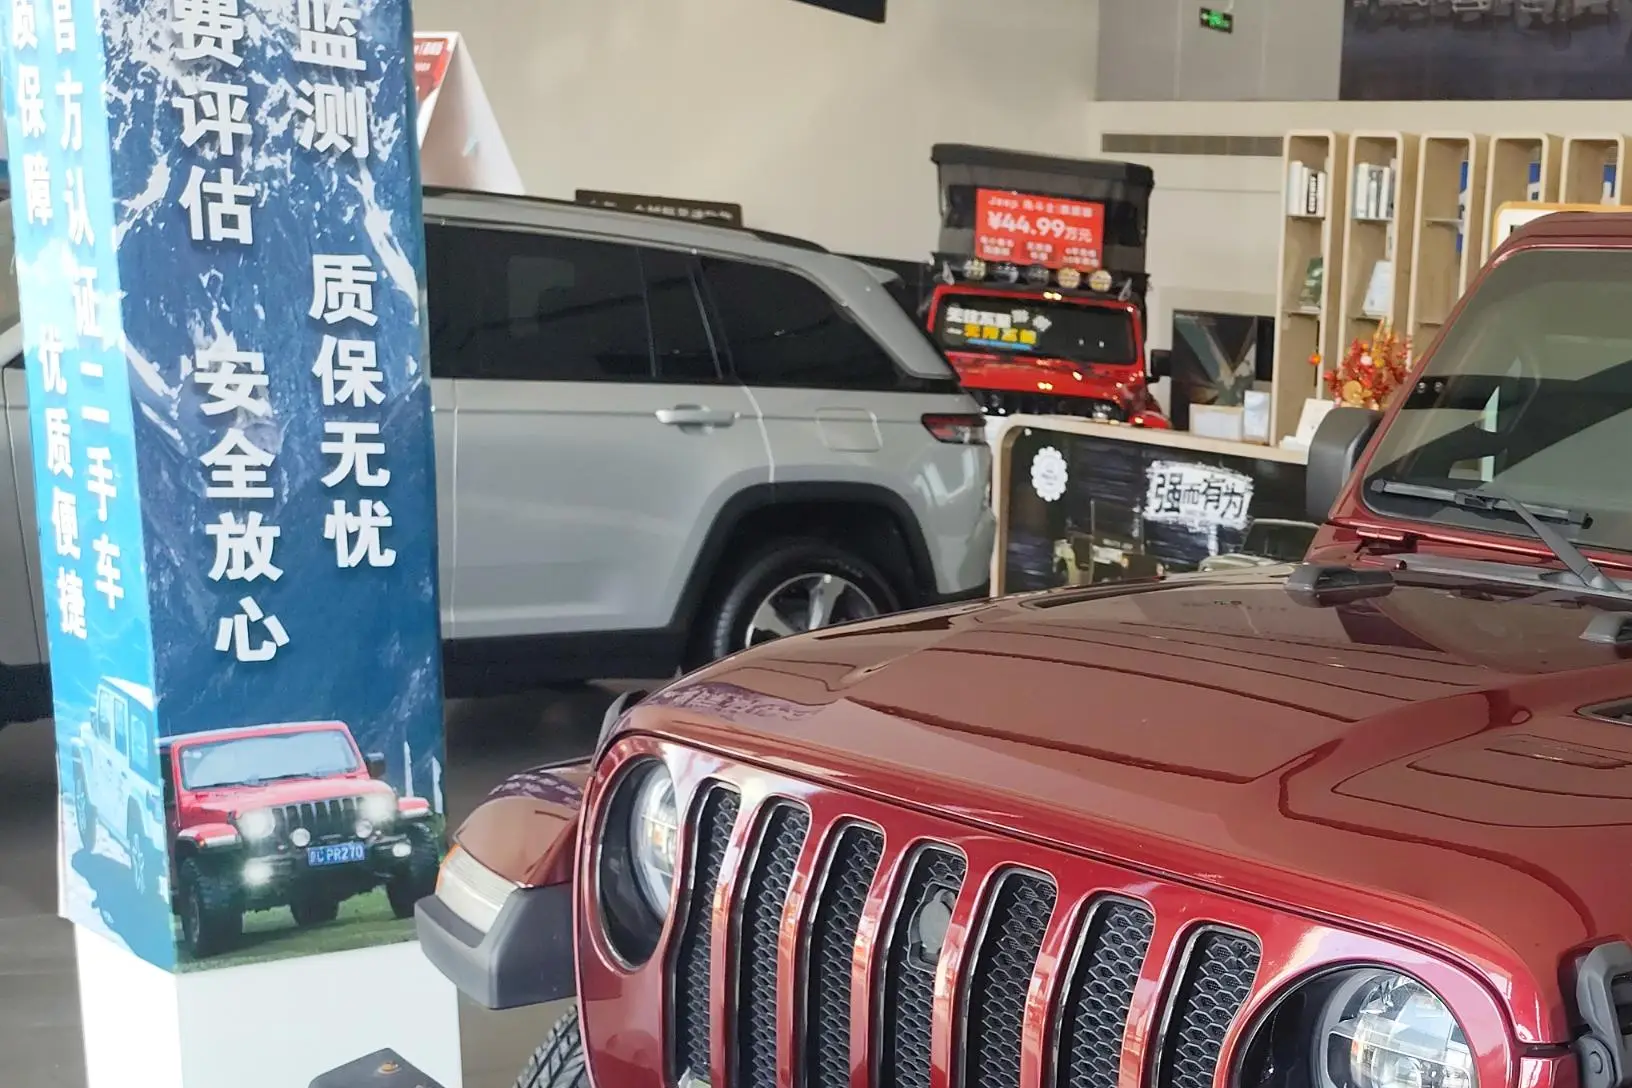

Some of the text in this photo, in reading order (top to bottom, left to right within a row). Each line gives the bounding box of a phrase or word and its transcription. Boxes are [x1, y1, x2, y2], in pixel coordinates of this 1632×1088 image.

[294, 0, 397, 568] 监测 质保无忧
[38, 322, 87, 640] 优质便捷
[194, 344, 290, 662] 安全放心
